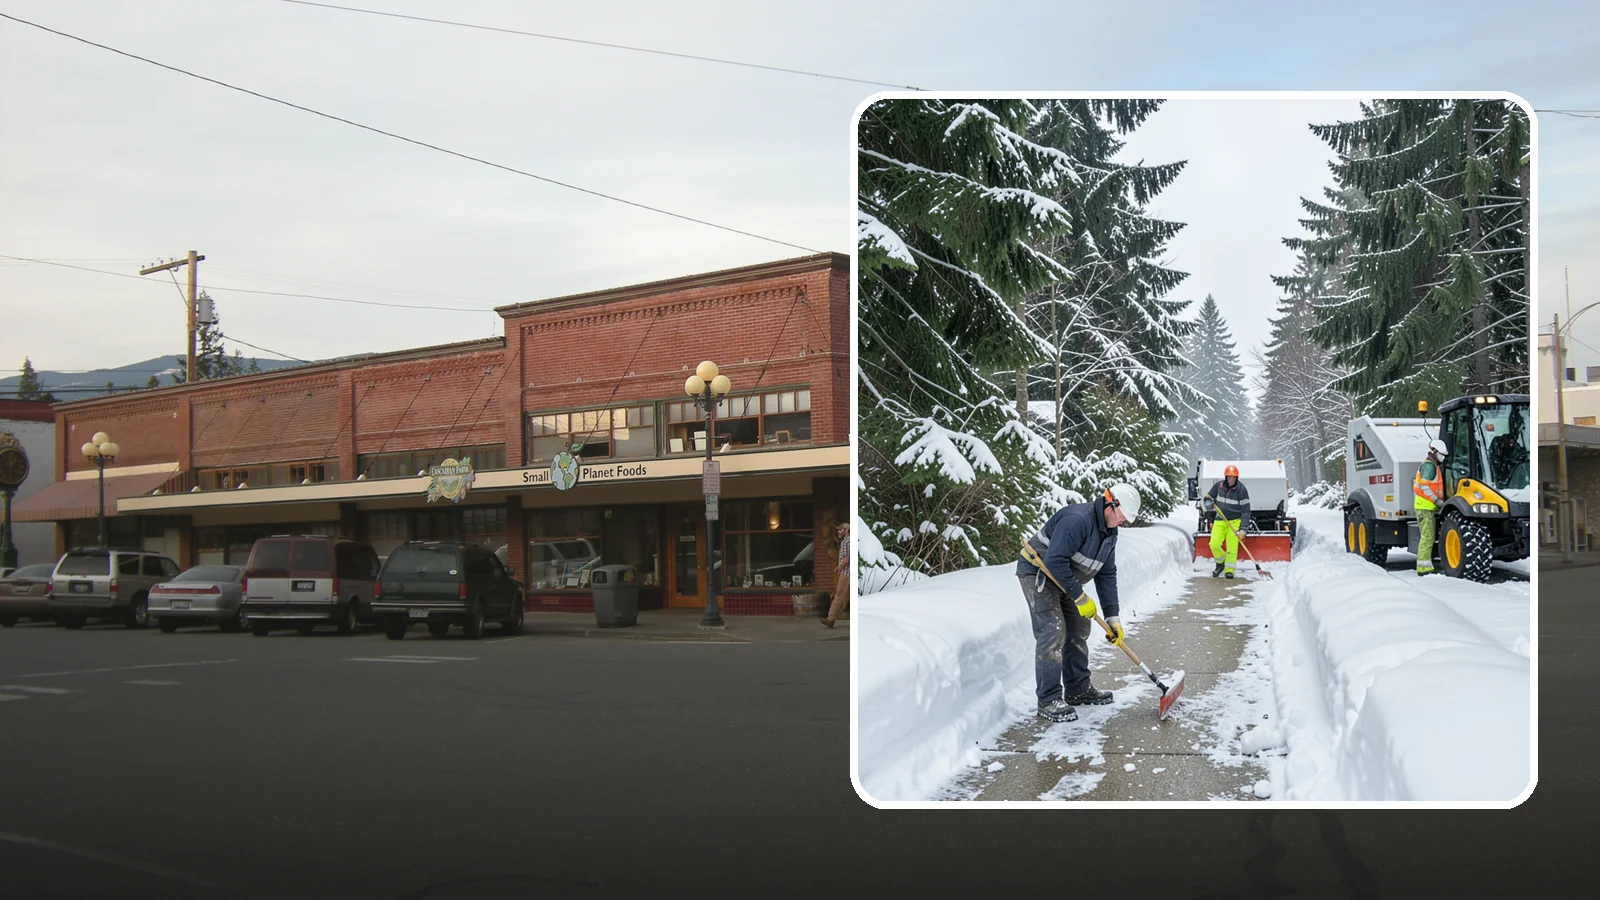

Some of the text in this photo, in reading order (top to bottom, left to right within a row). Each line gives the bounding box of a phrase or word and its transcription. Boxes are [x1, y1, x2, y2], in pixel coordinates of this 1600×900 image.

[432, 467, 455, 476] CASCADIAN
[523, 464, 647, 483] Small Planet Foods
